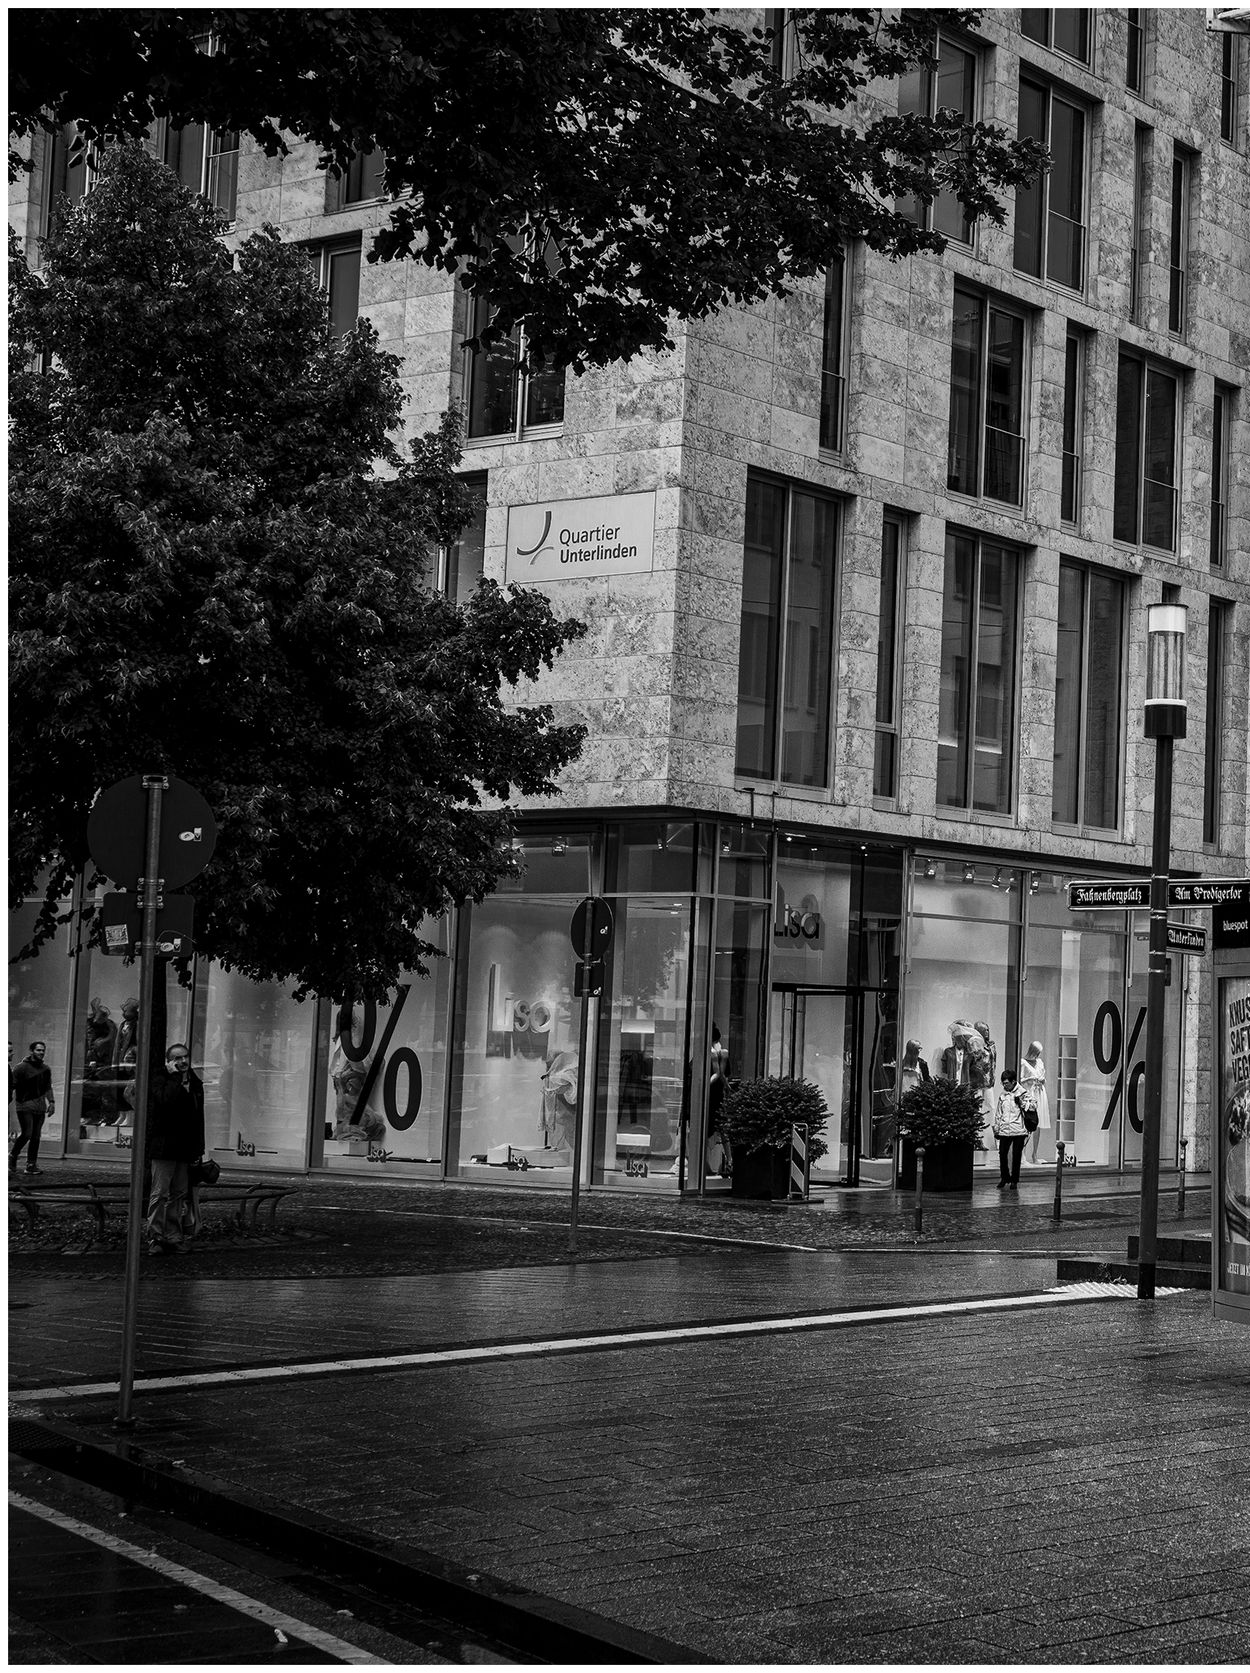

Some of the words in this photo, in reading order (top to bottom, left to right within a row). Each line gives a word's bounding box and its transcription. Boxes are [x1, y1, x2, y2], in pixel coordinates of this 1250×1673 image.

[559, 524, 621, 547] Quartier
[560, 543, 637, 564] Unterlinden
[1076, 887, 1142, 905] Fahnenbergplatz
[1174, 886, 1191, 900] Am
[1193, 885, 1243, 903] Predigertor
[1222, 919, 1249, 933] bluespot
